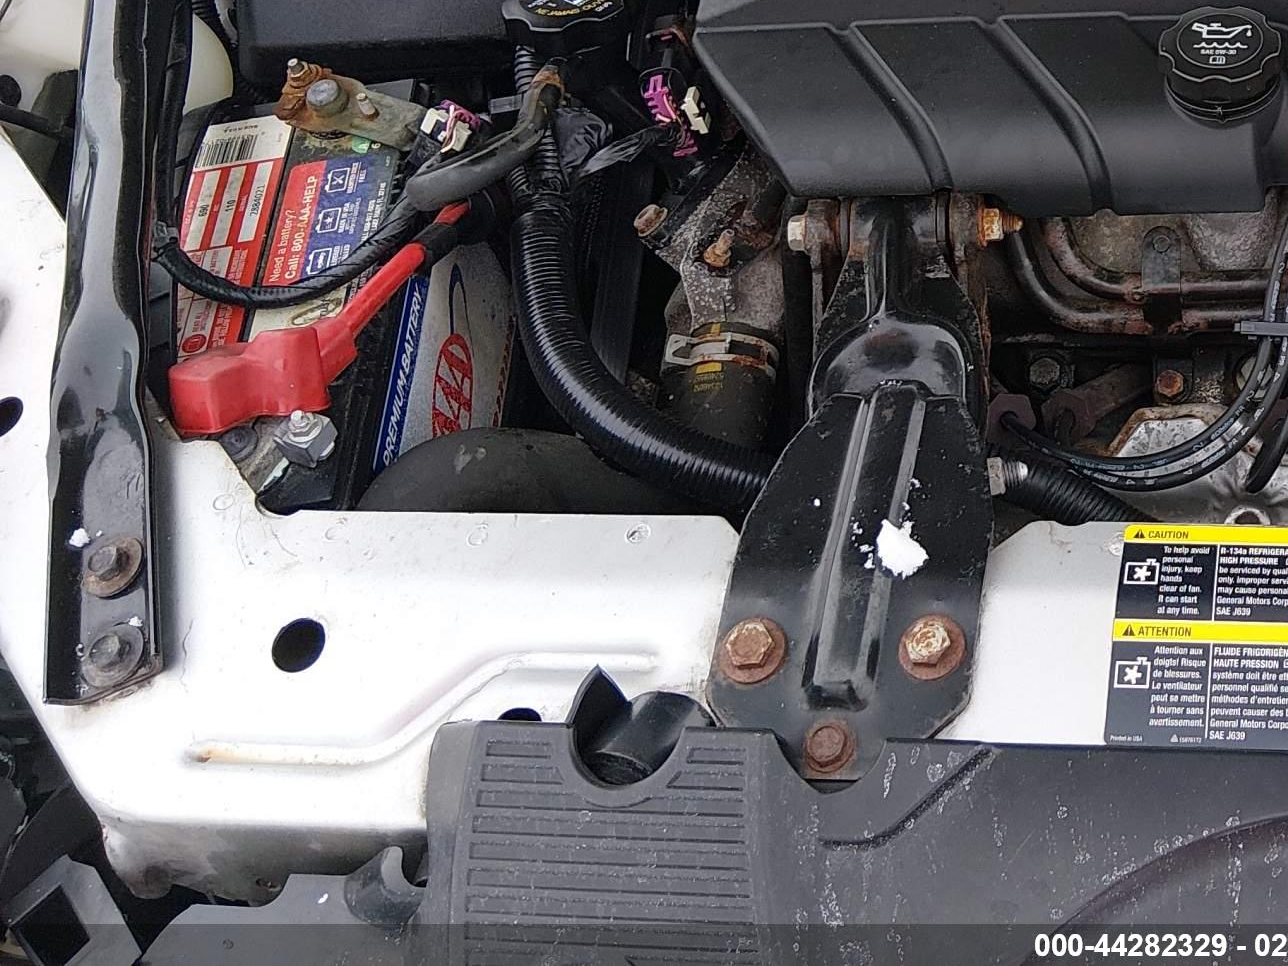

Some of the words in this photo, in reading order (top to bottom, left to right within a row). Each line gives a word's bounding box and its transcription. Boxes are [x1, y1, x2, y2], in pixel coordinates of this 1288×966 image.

[225, 199, 235, 212] 110
[250, 184, 265, 217] 2884021
[198, 204, 209, 217] 690
[291, 175, 318, 252] 800-AAA-HELP
[269, 257, 284, 282] Need
[278, 210, 296, 248] battery?
[285, 254, 300, 279] Call:
[383, 377, 408, 467] PREMIUM
[401, 283, 423, 376] BATTERY
[1148, 530, 1190, 539] CAUTION
[1173, 546, 1190, 555] help
[1190, 546, 1210, 554] avoid
[1220, 547, 1247, 555] R-134a
[1161, 556, 1194, 564] personal
[1239, 557, 1279, 565] PRESSURE
[1184, 566, 1203, 574] keep
[1229, 566, 1261, 574] serviced
[1236, 576, 1270, 585] Improper
[1159, 584, 1177, 592] clear
[1180, 595, 1198, 603] start
[1216, 596, 1245, 604] General
[1245, 597, 1271, 605] Motors
[1216, 607, 1231, 615] SAE
[1138, 626, 1192, 637] ATTENTION
[1154, 645, 1189, 654] Attention
[1214, 647, 1241, 656] FLUIDE
[1180, 658, 1207, 668] Risque
[1213, 659, 1239, 668] HAUTE
[1240, 659, 1279, 669] PRESSION
[1162, 681, 1203, 691] ventilateur
[1212, 682, 1249, 693] personnel
[1150, 693, 1169, 704] peut
[1180, 694, 1206, 703] mettre
[1156, 704, 1185, 714] tourner
[1185, 707, 1204, 715] sans
[1210, 706, 1241, 717] peuvent
[1210, 719, 1239, 728] General
[1240, 719, 1266, 729] Motors
[1209, 731, 1225, 740] SAE
